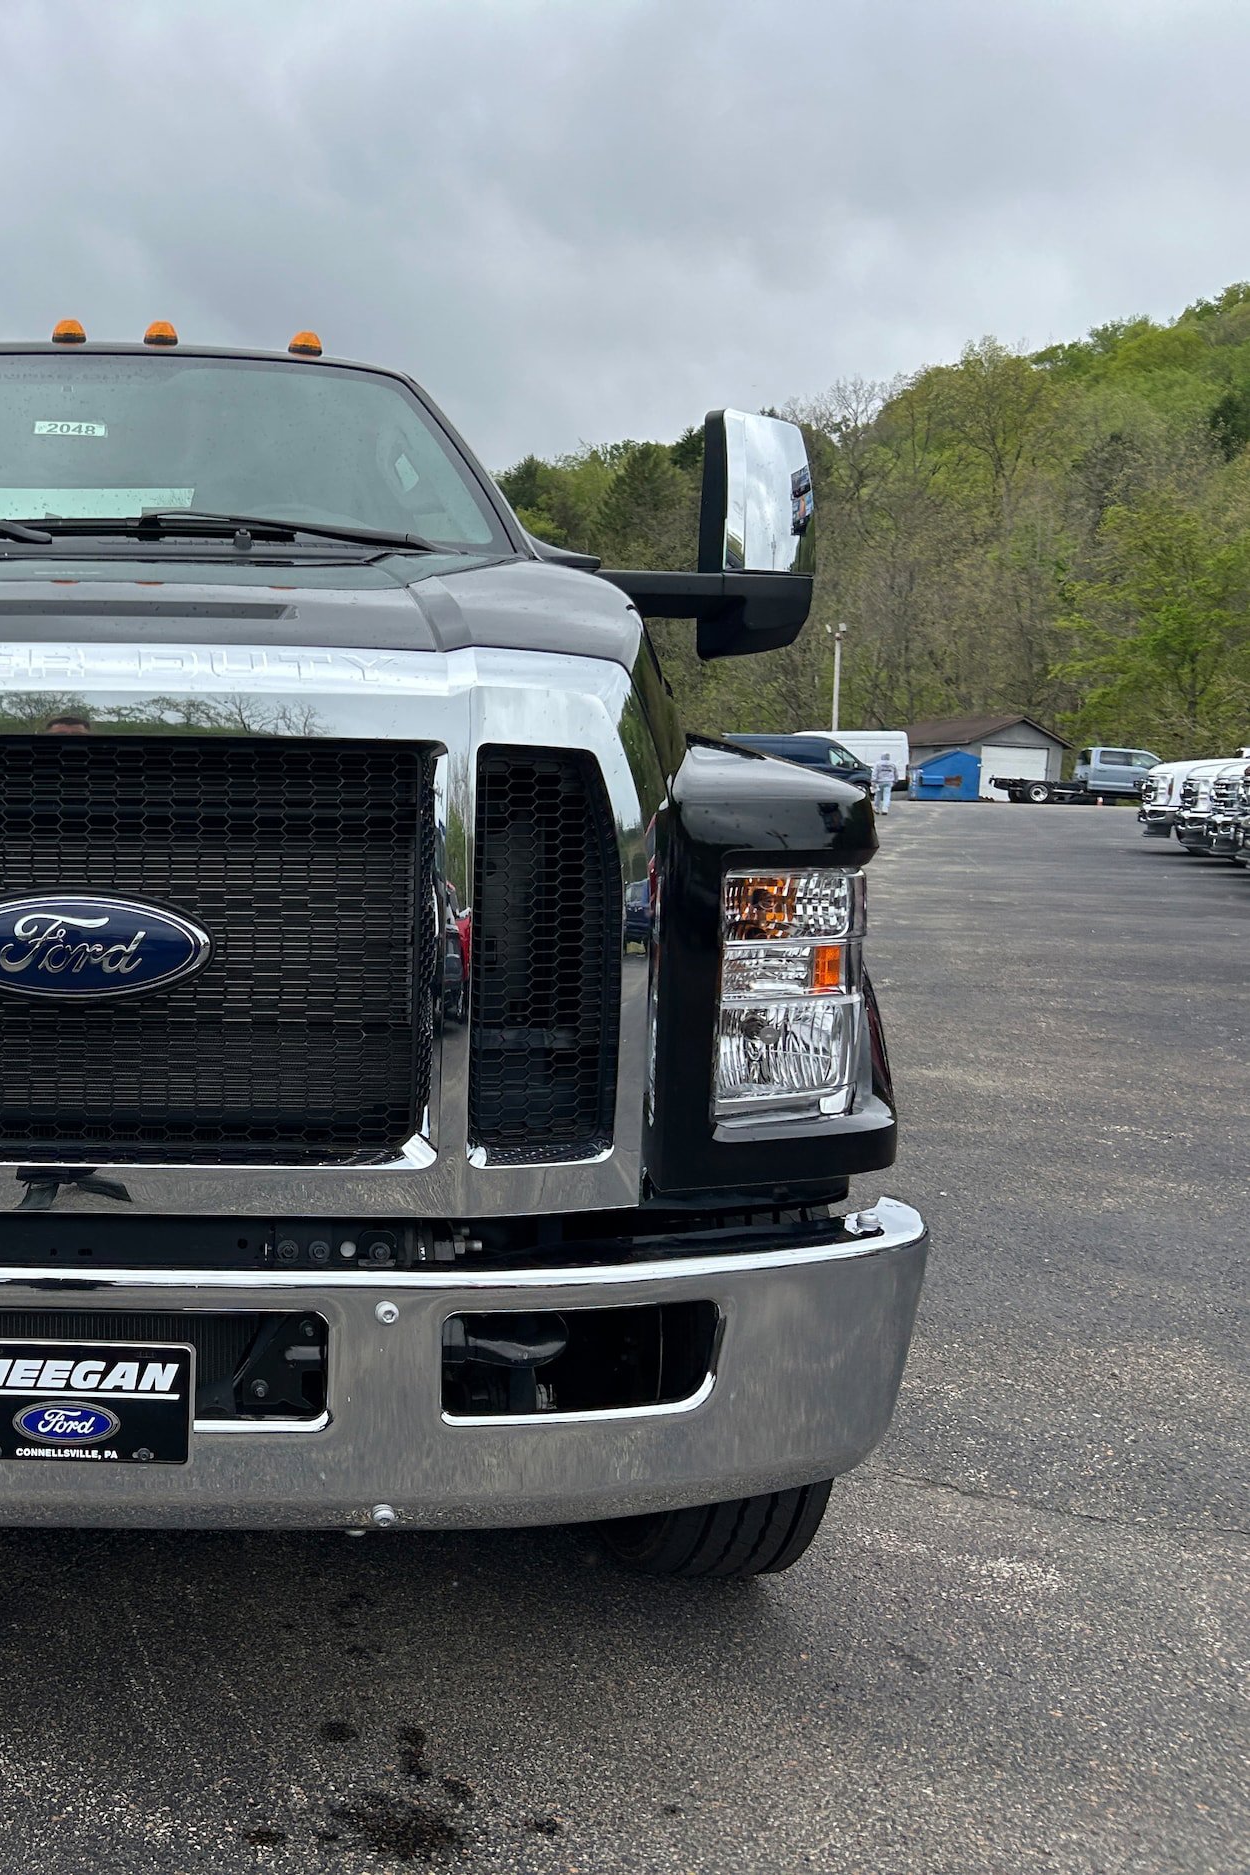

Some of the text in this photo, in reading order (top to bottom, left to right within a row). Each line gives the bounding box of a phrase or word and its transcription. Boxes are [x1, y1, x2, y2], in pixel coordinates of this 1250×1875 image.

[46, 423, 96, 435] 2048
[137, 650, 396, 682] DUTY
[0, 913, 146, 974] Ford
[37, 1409, 96, 1434] Ford
[15, 1447, 118, 1460] CONNELLSVILLE, PA
